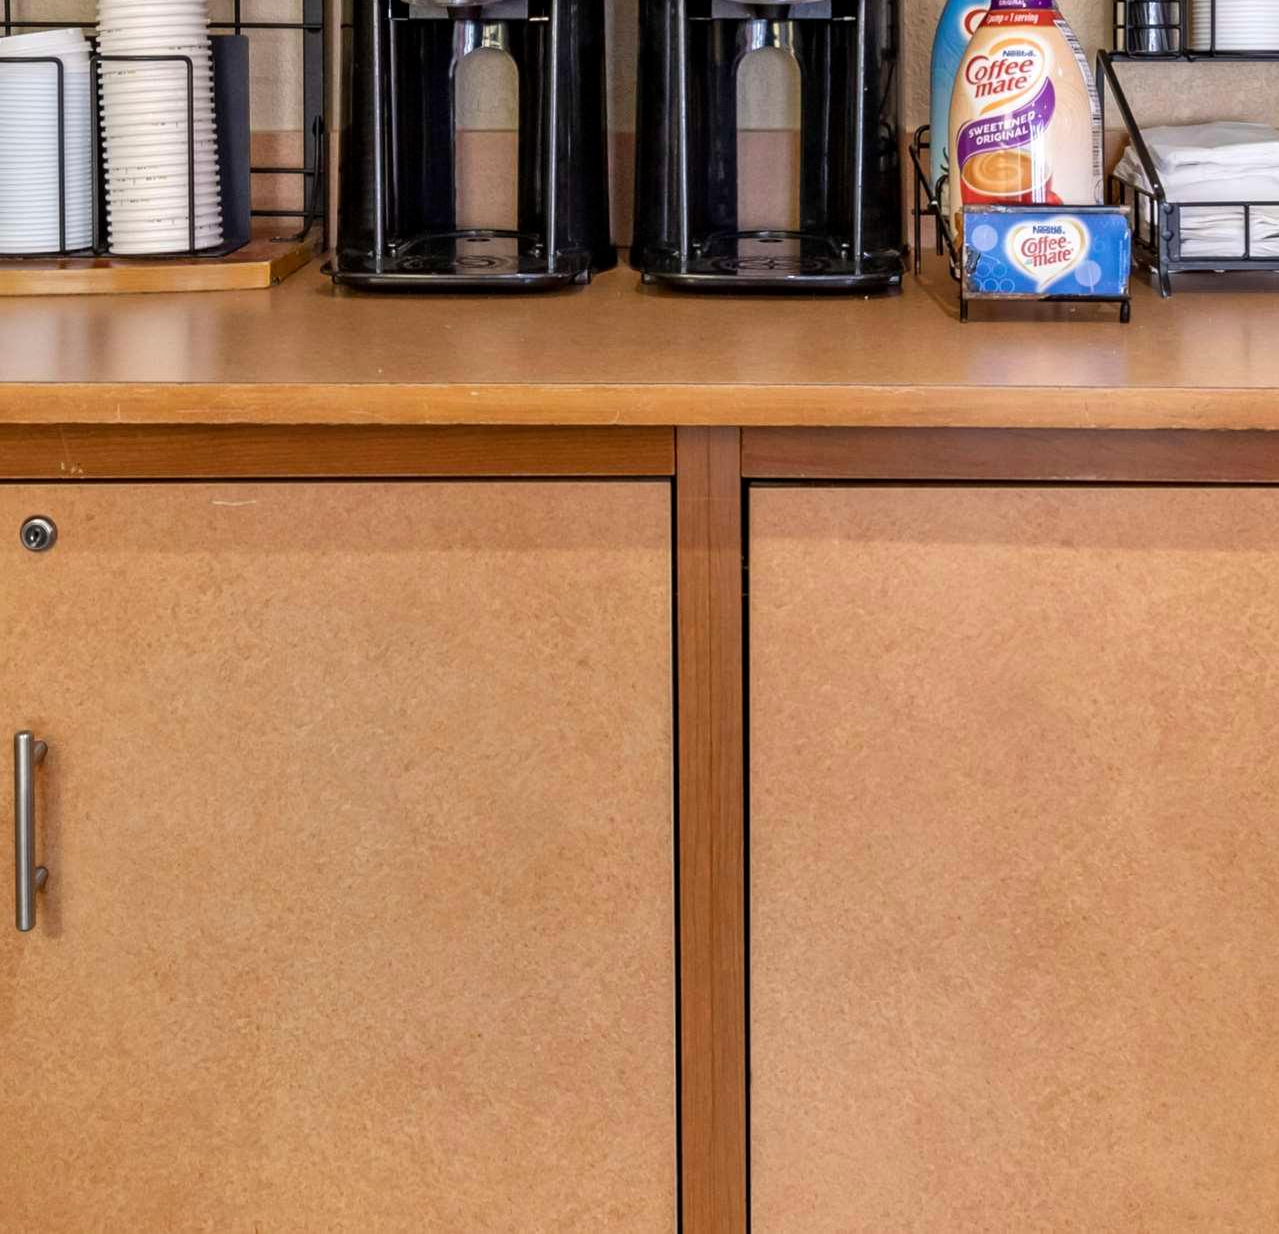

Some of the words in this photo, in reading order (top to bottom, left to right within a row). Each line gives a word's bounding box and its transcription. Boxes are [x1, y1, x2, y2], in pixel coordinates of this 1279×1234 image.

[965, 55, 1034, 86] Coffee
[975, 76, 1028, 99] mate
[968, 110, 1036, 138] SWEETENED
[976, 125, 1029, 146] ORIGINAL
[1032, 248, 1072, 267] mate
